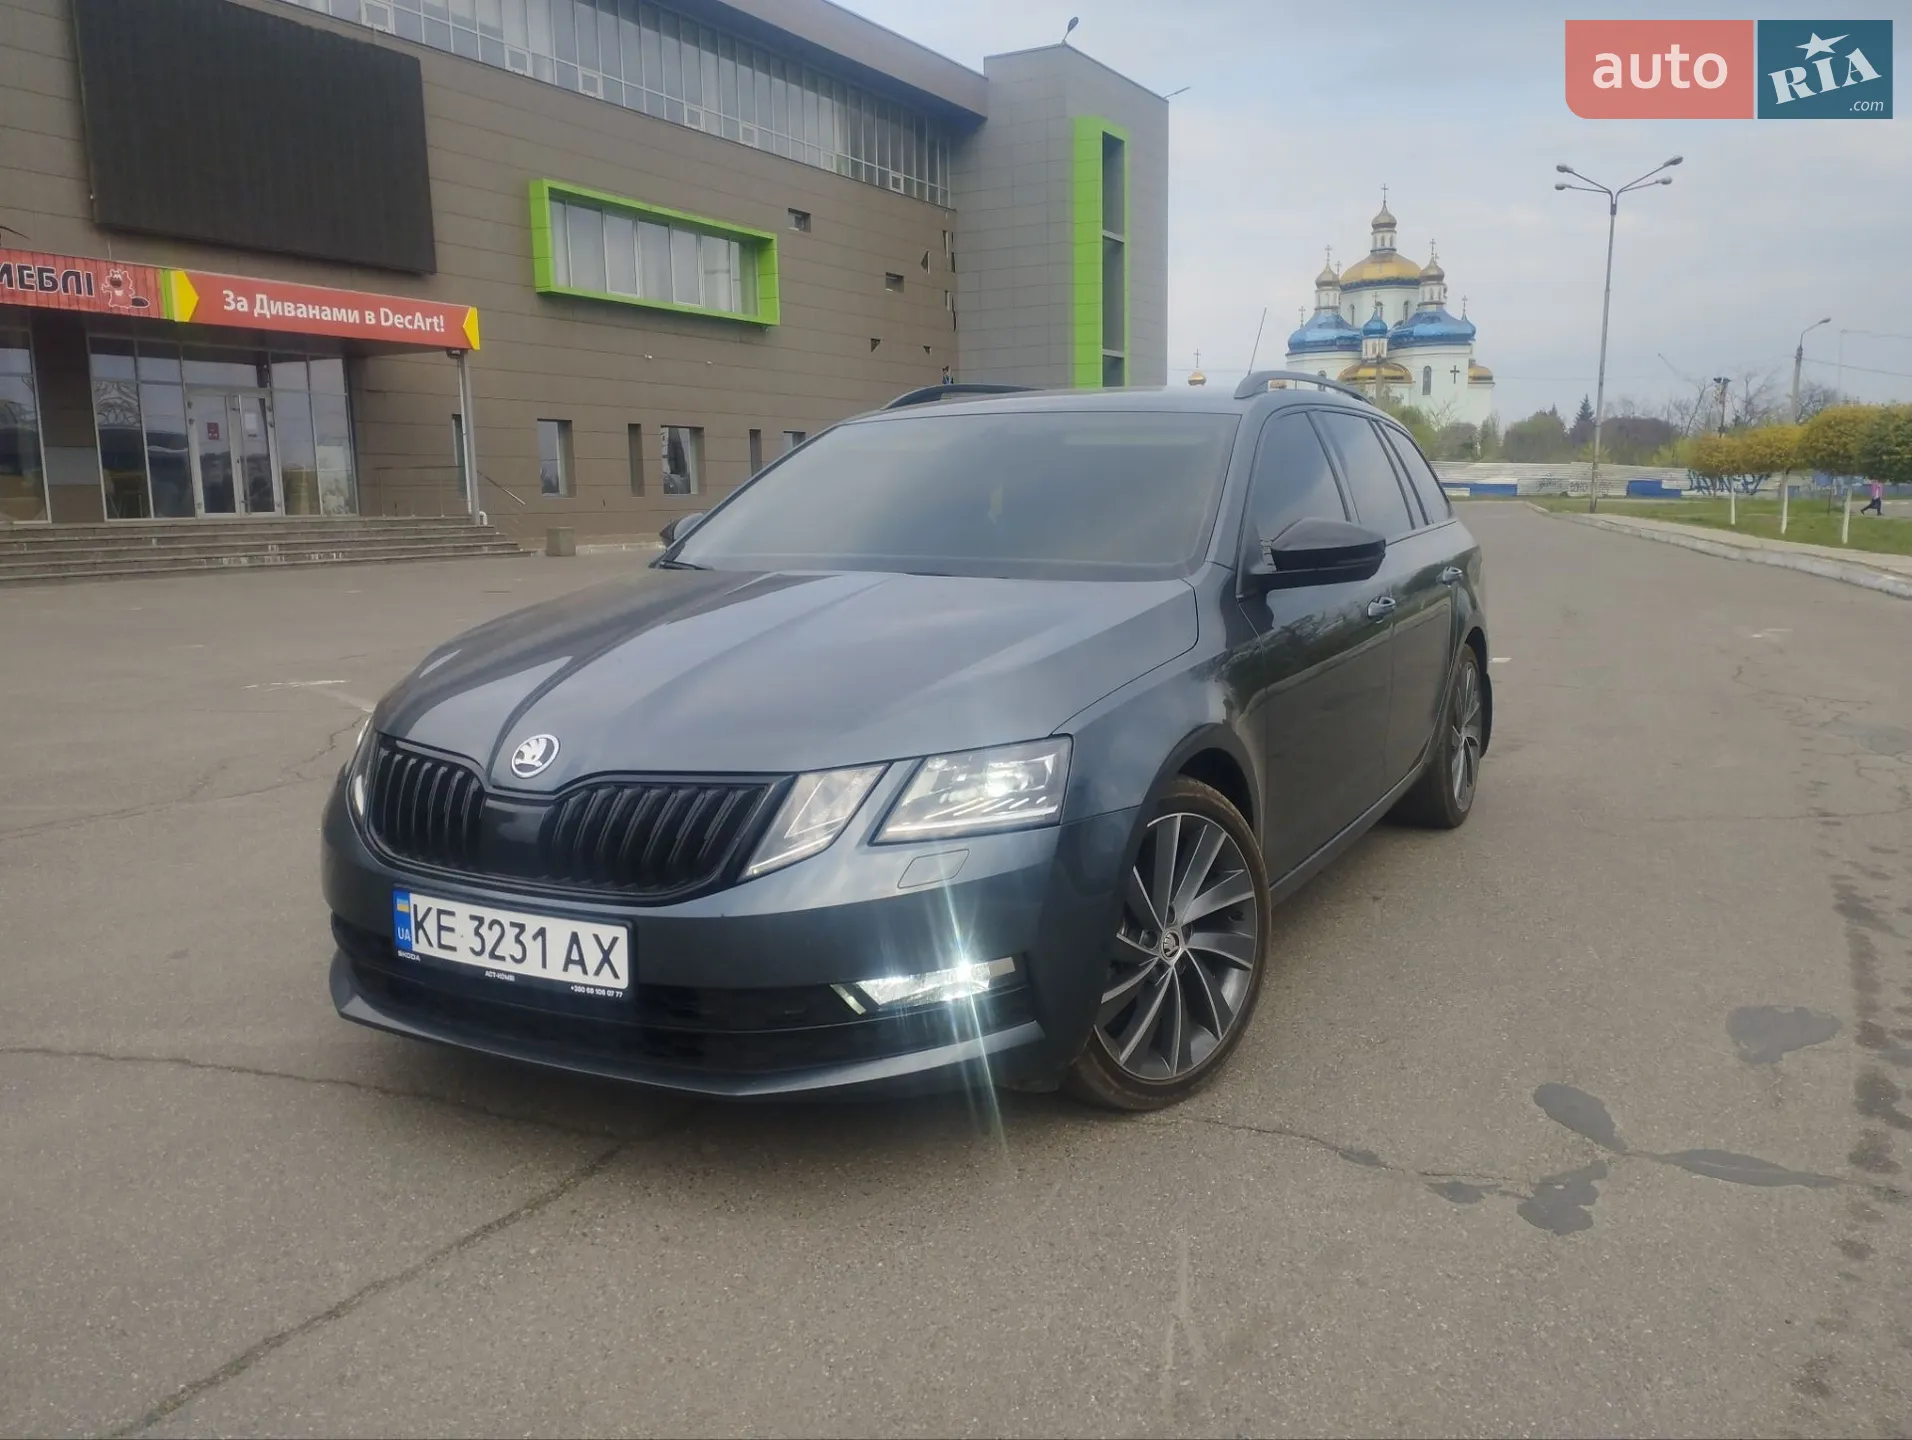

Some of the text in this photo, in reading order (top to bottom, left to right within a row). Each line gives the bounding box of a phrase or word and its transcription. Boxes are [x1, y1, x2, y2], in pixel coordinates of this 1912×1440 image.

[222, 289, 445, 332] За Диванами в DecArt!
[397, 926, 411, 941] UA
[412, 903, 621, 980] KE 3231 AX
